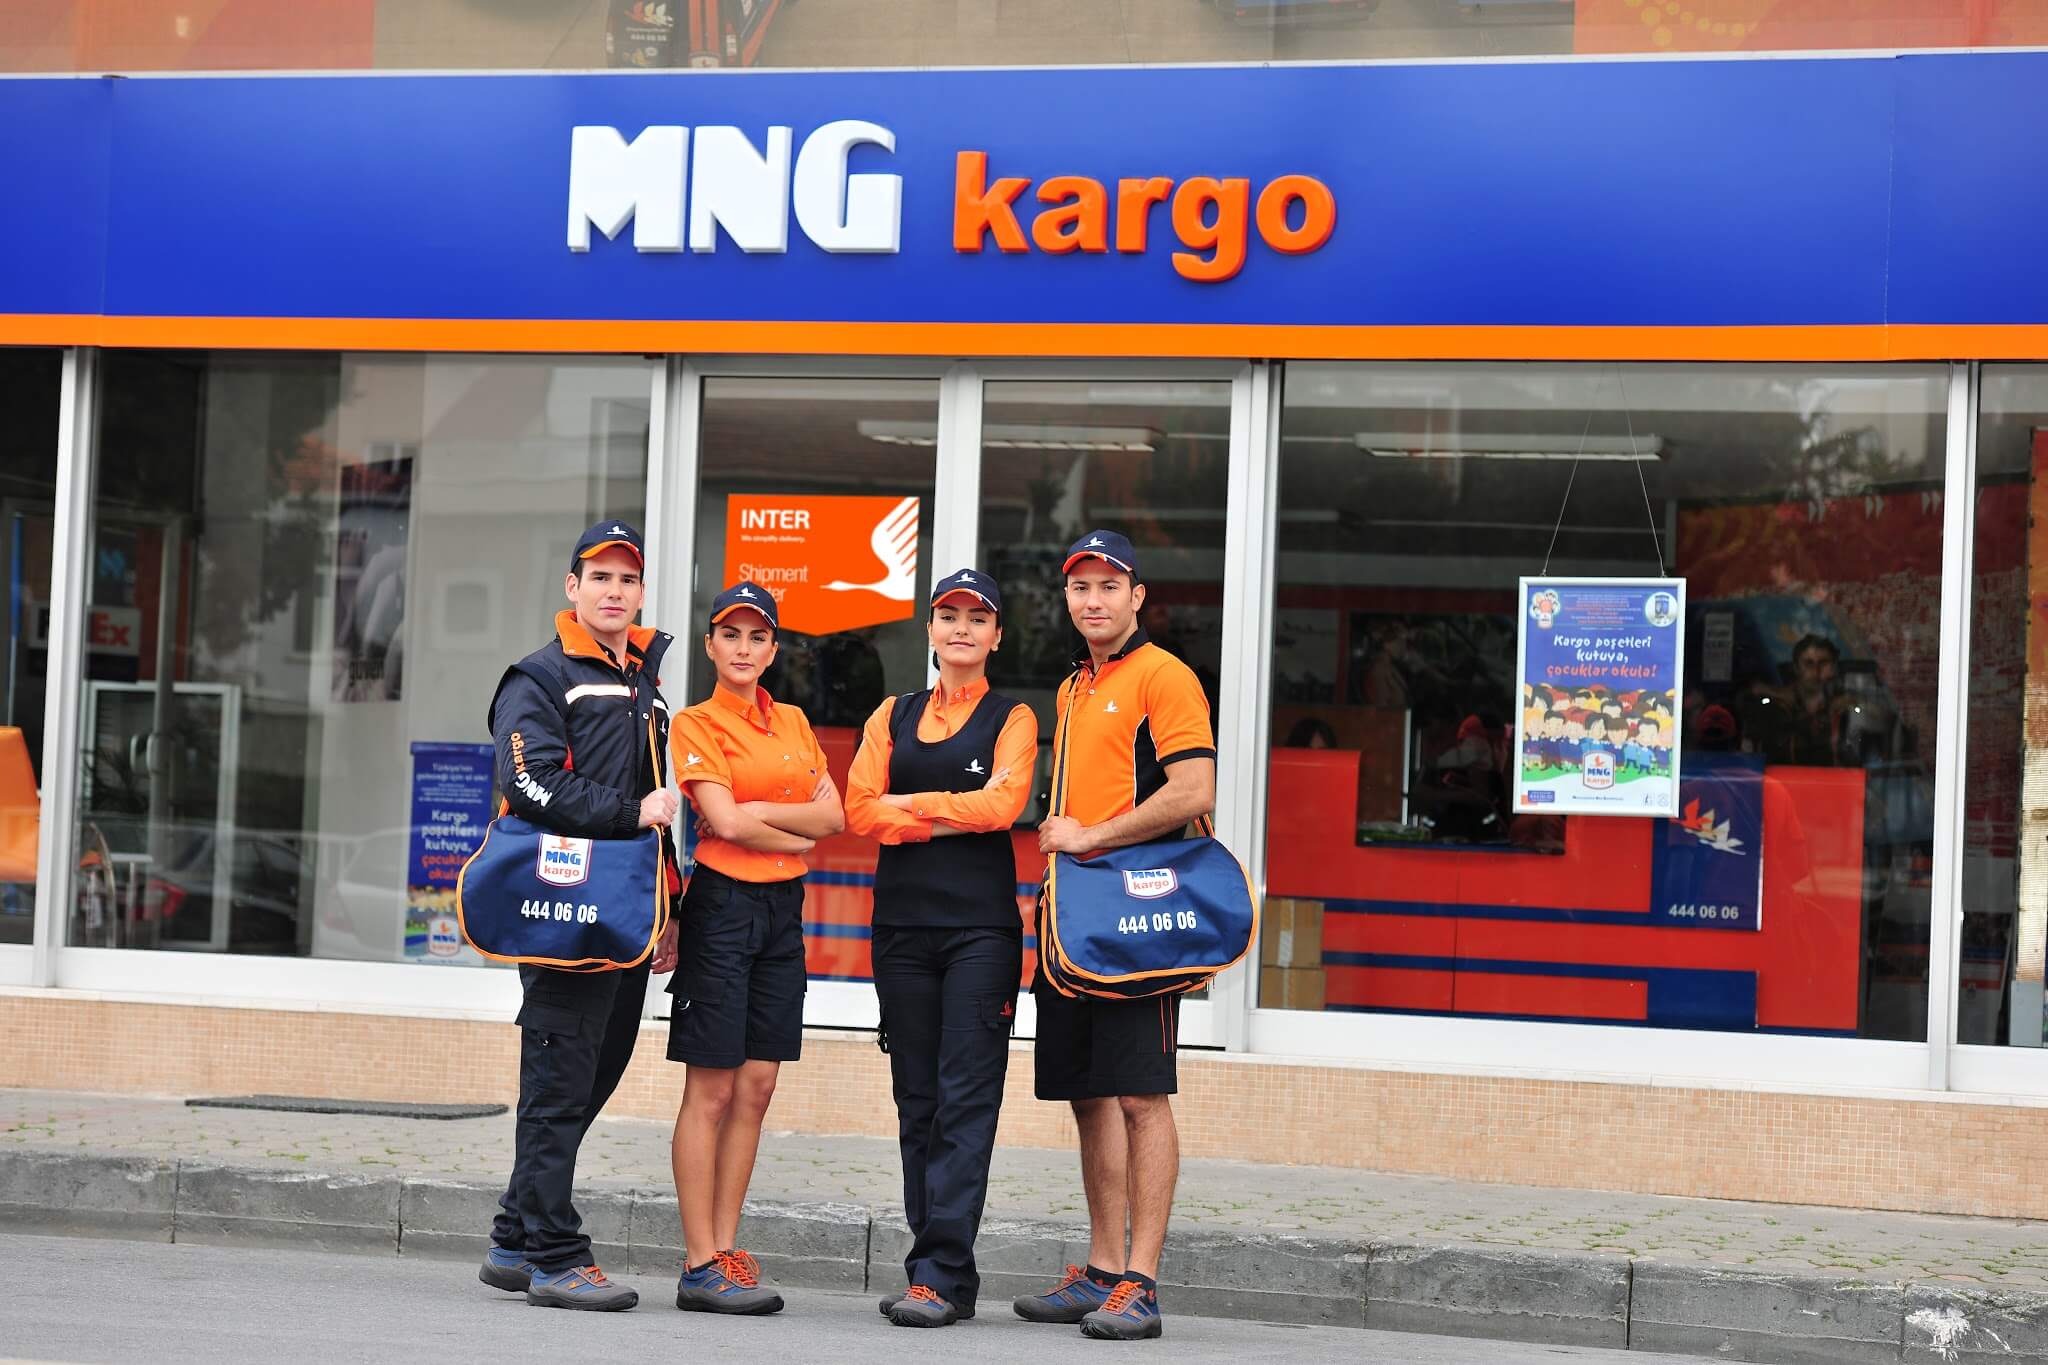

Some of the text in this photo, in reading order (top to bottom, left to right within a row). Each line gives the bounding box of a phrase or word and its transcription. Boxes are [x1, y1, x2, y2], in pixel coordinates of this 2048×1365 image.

[567, 119, 1336, 282] MNG kargo
[741, 508, 810, 530] INTER
[739, 563, 809, 585] Shipment
[1553, 635, 1653, 650] Kargo poşetleri
[1546, 664, 1657, 678] çocuklar okula!
[510, 732, 553, 808] MNG kargo
[1587, 767, 1611, 777] MNG
[431, 809, 468, 827] Kargo
[421, 825, 478, 839] poşetleri
[545, 850, 582, 866] MNG
[543, 865, 580, 878] kargo
[1133, 879, 1170, 890] kargo
[520, 899, 598, 924] 444 06 06
[1668, 904, 1739, 919] 444 06 06
[1118, 910, 1197, 934] 444 06 06
